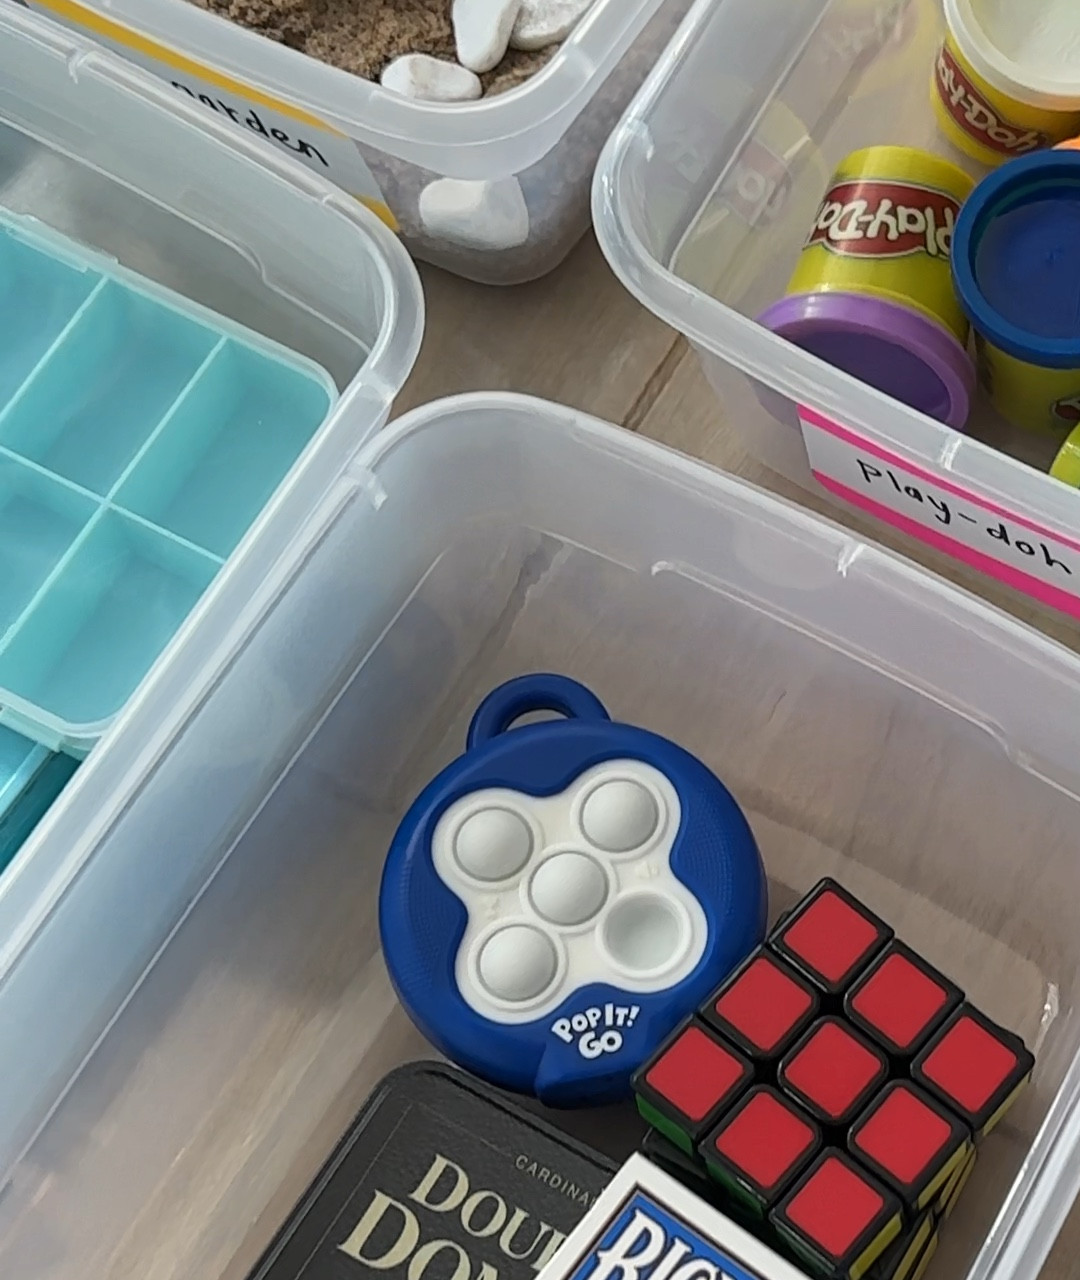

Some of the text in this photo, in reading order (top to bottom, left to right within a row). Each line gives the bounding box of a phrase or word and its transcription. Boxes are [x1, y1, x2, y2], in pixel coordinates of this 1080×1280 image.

[551, 1003, 640, 1043] POP IT!
[578, 1030, 623, 1059] GO
[515, 1154, 604, 1210] CARDINA
